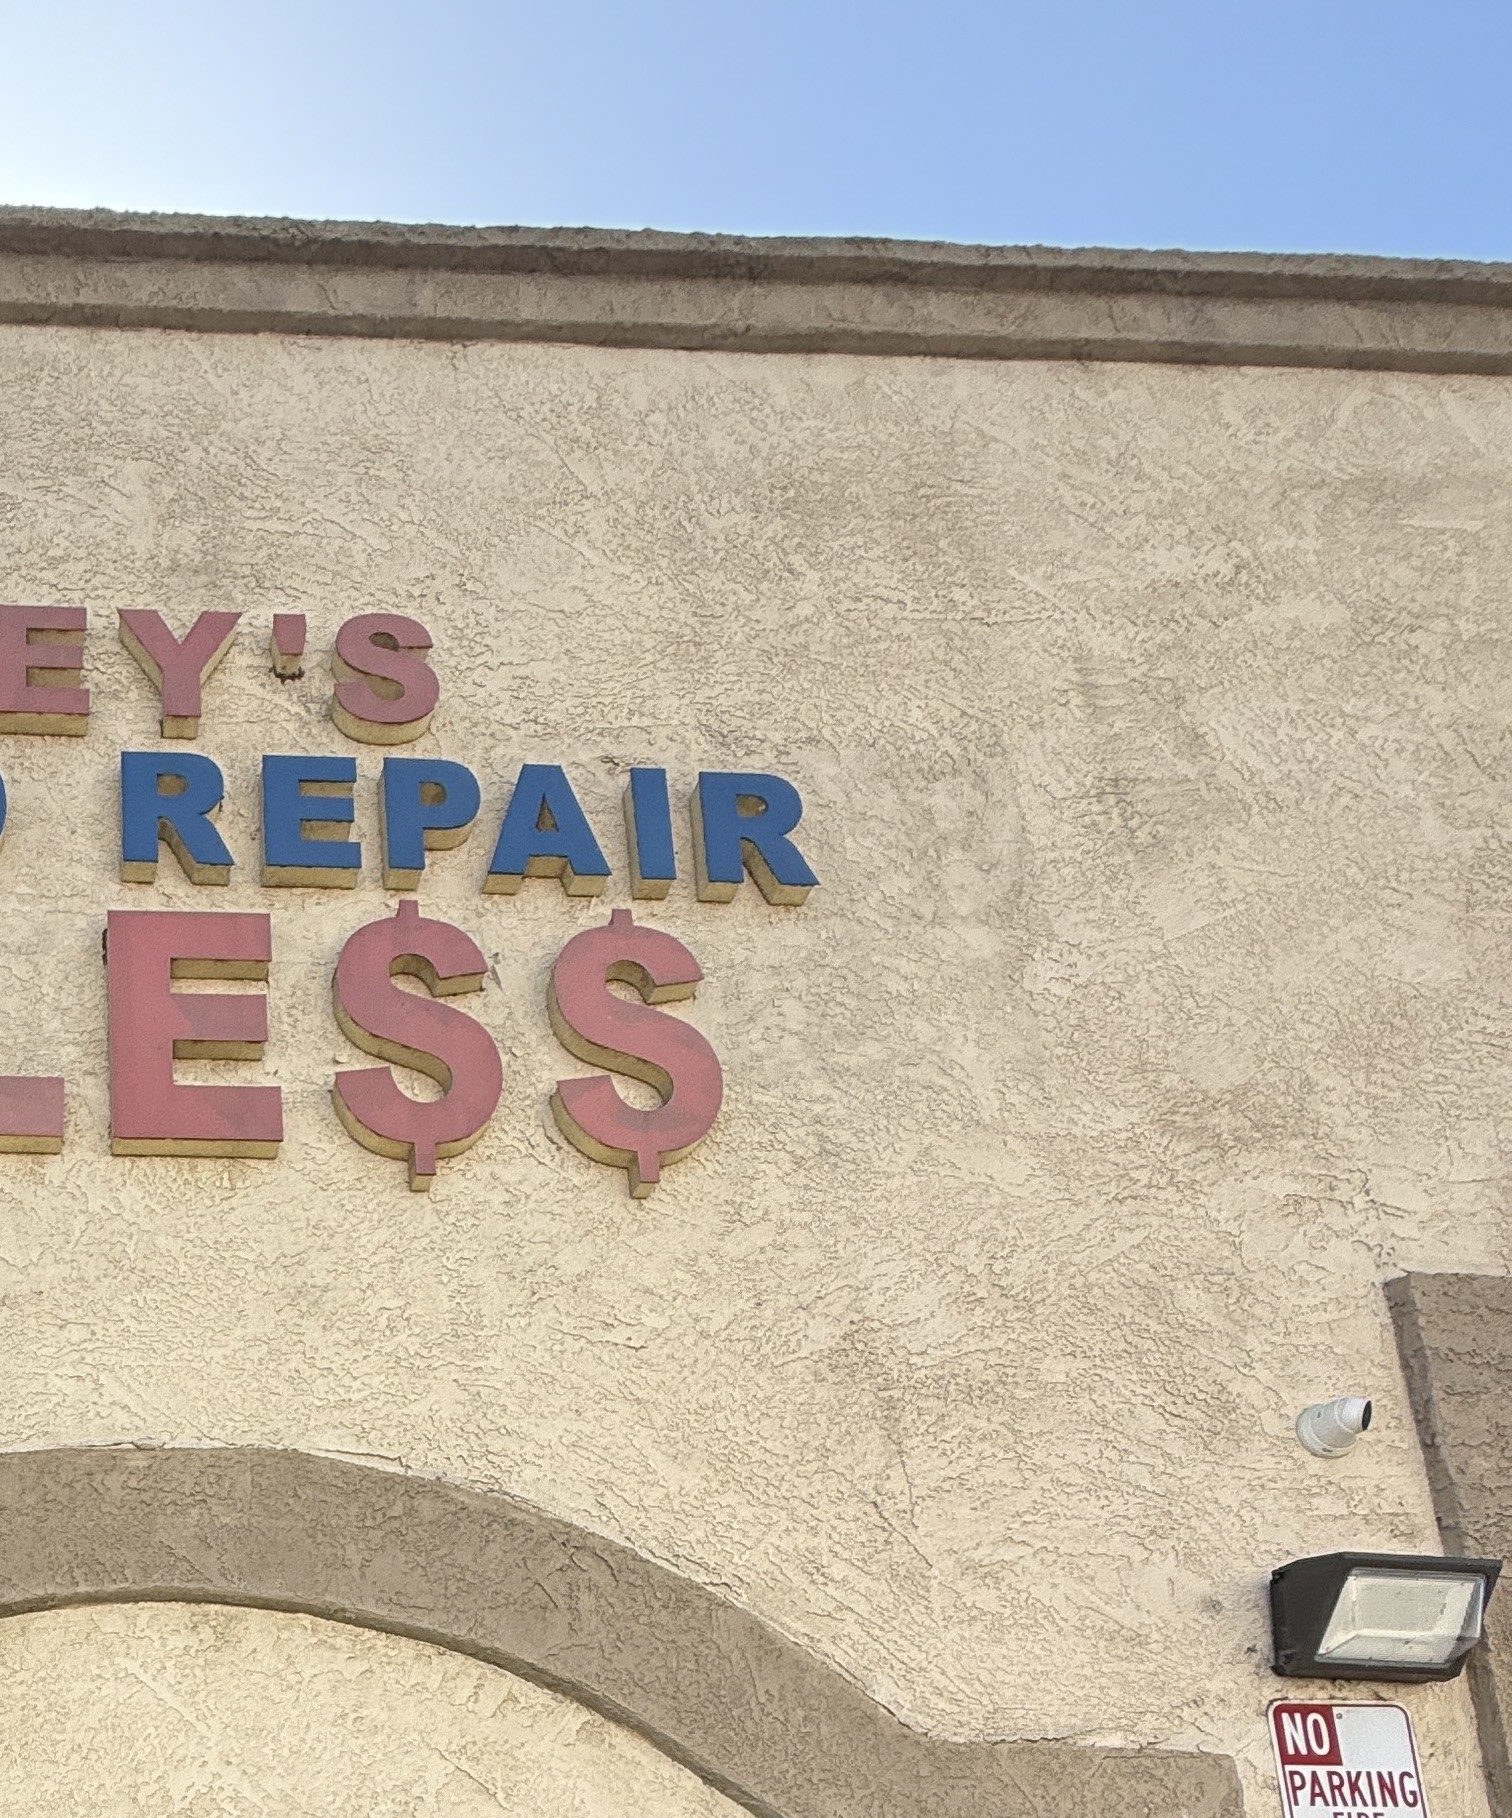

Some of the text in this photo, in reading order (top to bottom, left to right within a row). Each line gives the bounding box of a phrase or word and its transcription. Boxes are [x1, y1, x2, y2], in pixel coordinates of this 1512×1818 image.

[120, 750, 819, 905] REPAIR
[1281, 1712, 1330, 1756] NO
[1288, 1770, 1419, 1808] PARKING
